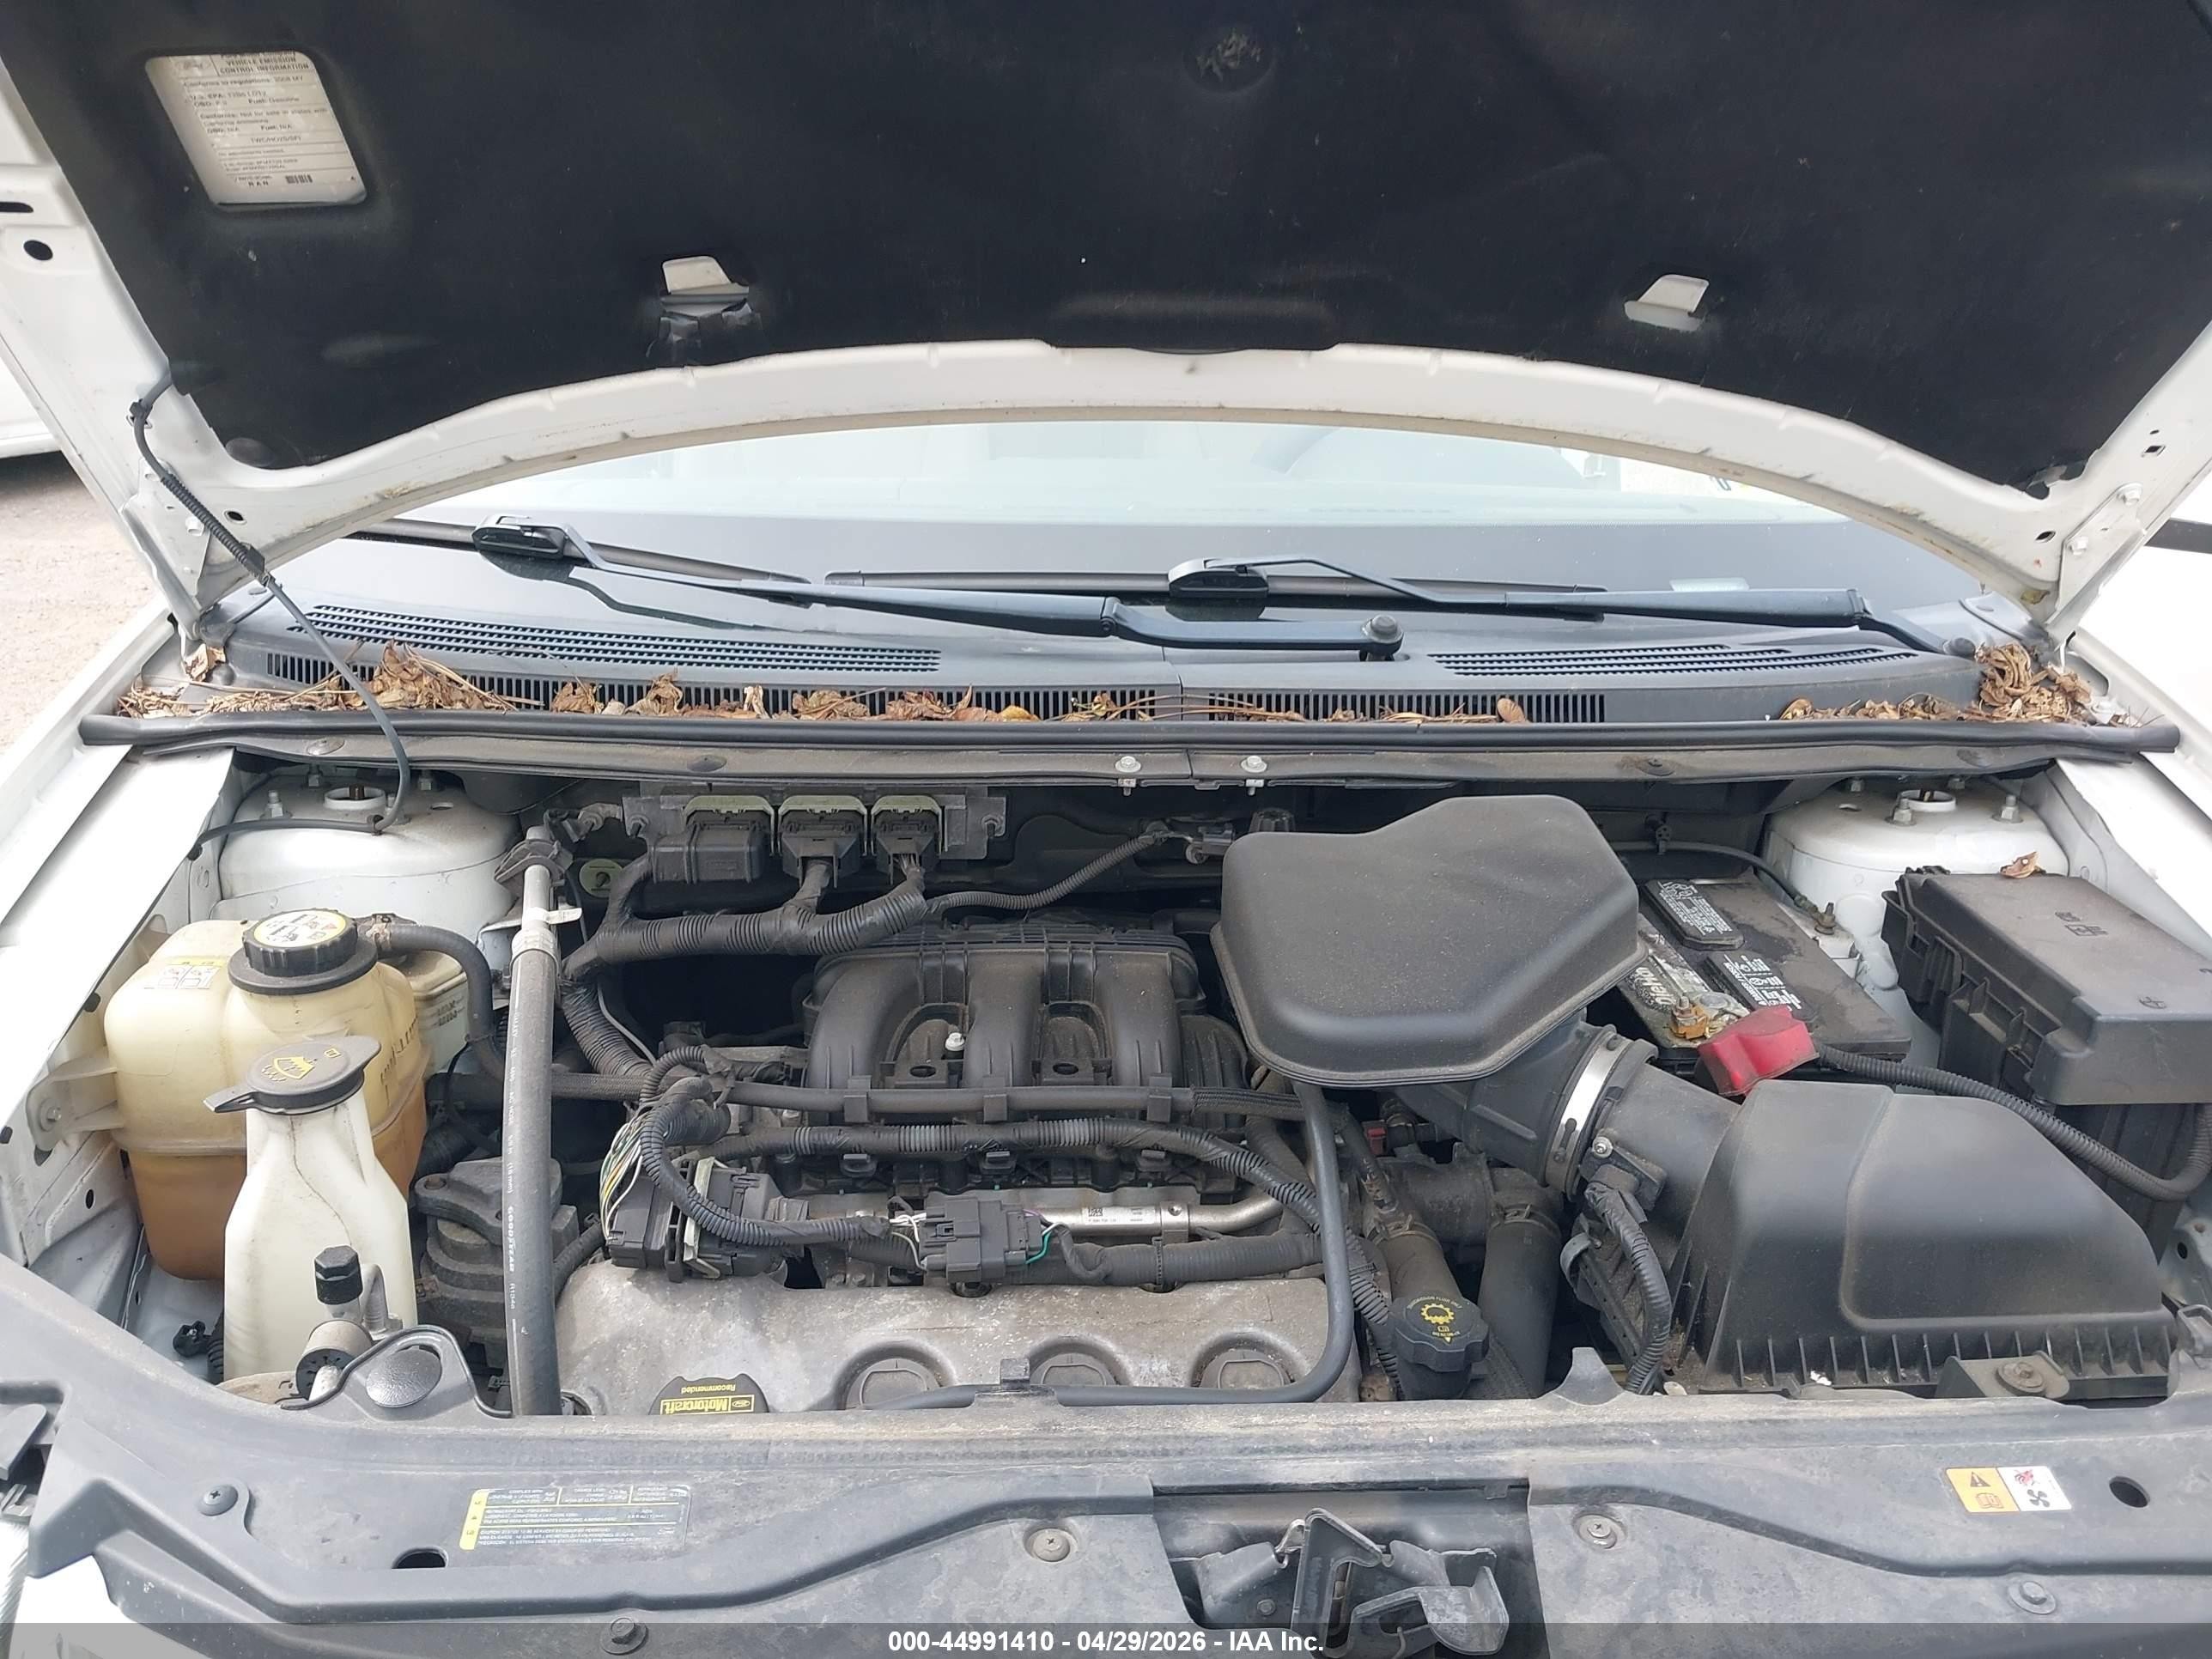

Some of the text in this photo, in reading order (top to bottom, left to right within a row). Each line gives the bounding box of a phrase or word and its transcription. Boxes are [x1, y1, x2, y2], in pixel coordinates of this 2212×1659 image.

[257, 64, 309, 72] INFORMATION
[507, 1206, 516, 1272] GOODYEAR
[680, 1383, 736, 1395] Recommended
[664, 1397, 729, 1415] Motorcraft
